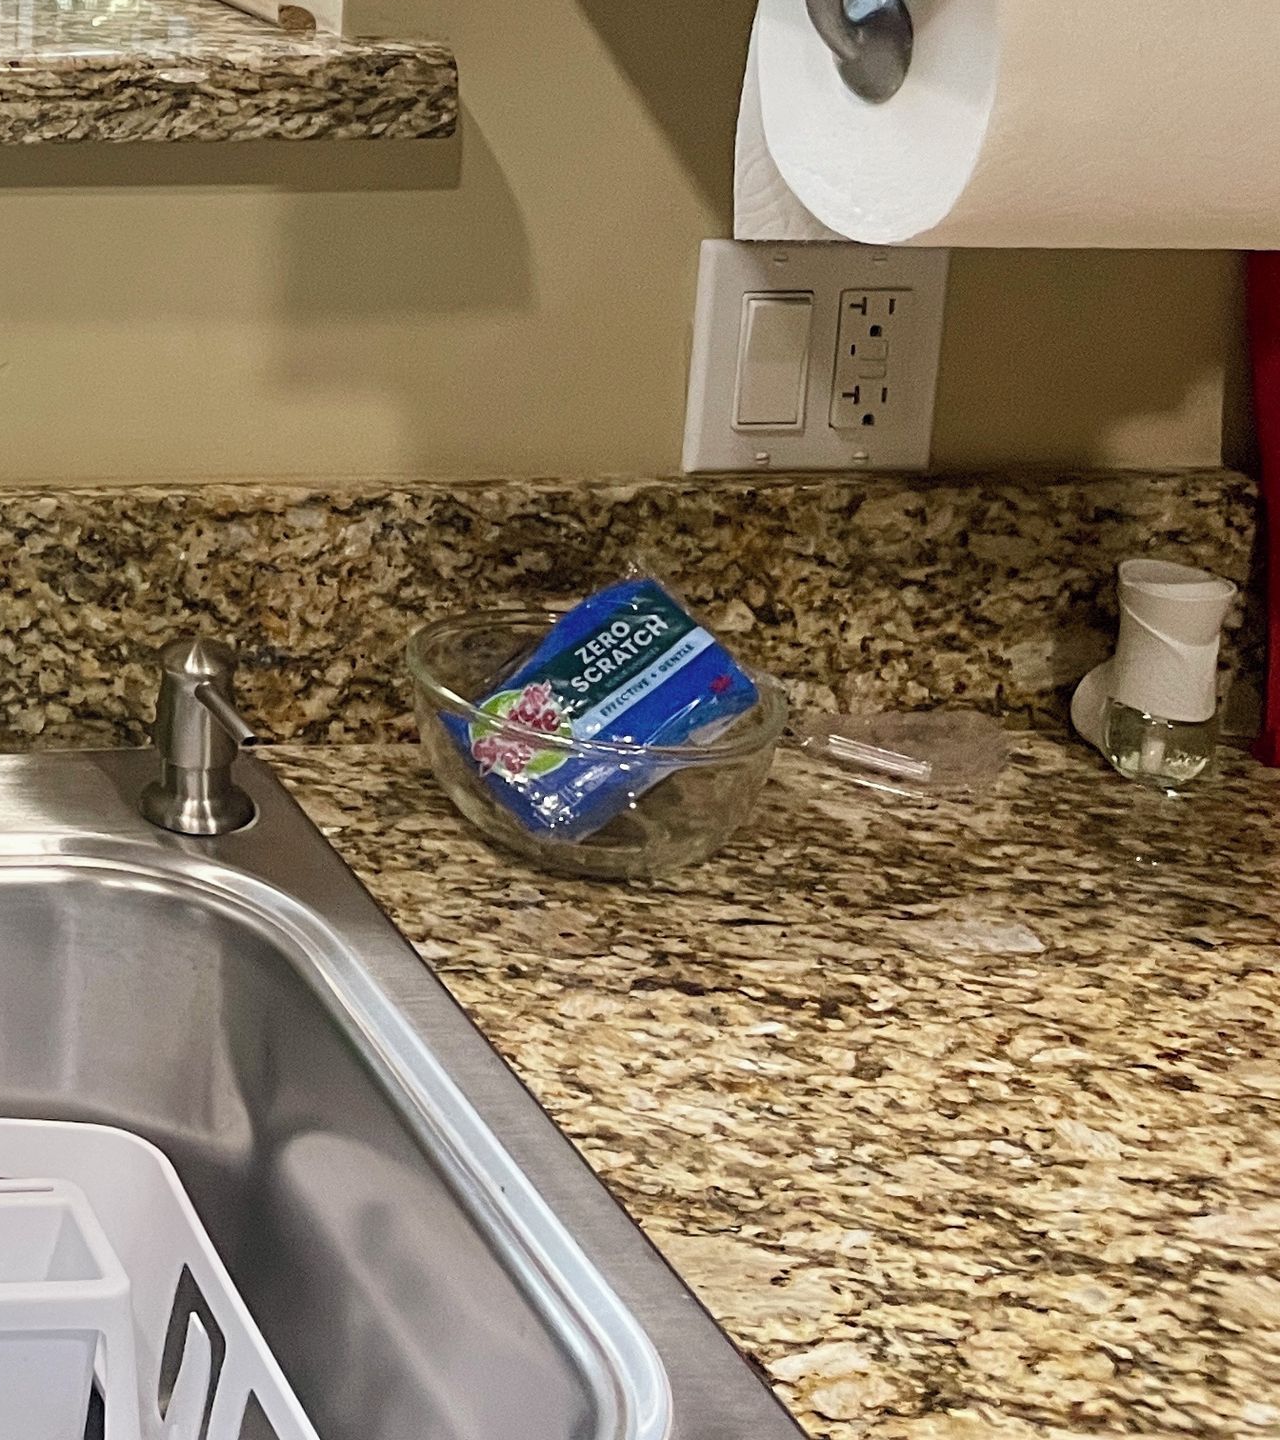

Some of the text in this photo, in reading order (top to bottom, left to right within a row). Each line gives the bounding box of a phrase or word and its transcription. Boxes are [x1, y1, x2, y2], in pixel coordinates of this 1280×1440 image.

[571, 615, 669, 692] SCRATCH
[574, 621, 630, 664] ZERO
[600, 678, 649, 716] EFFECTIVE
[658, 644, 695, 672] GENTLE
